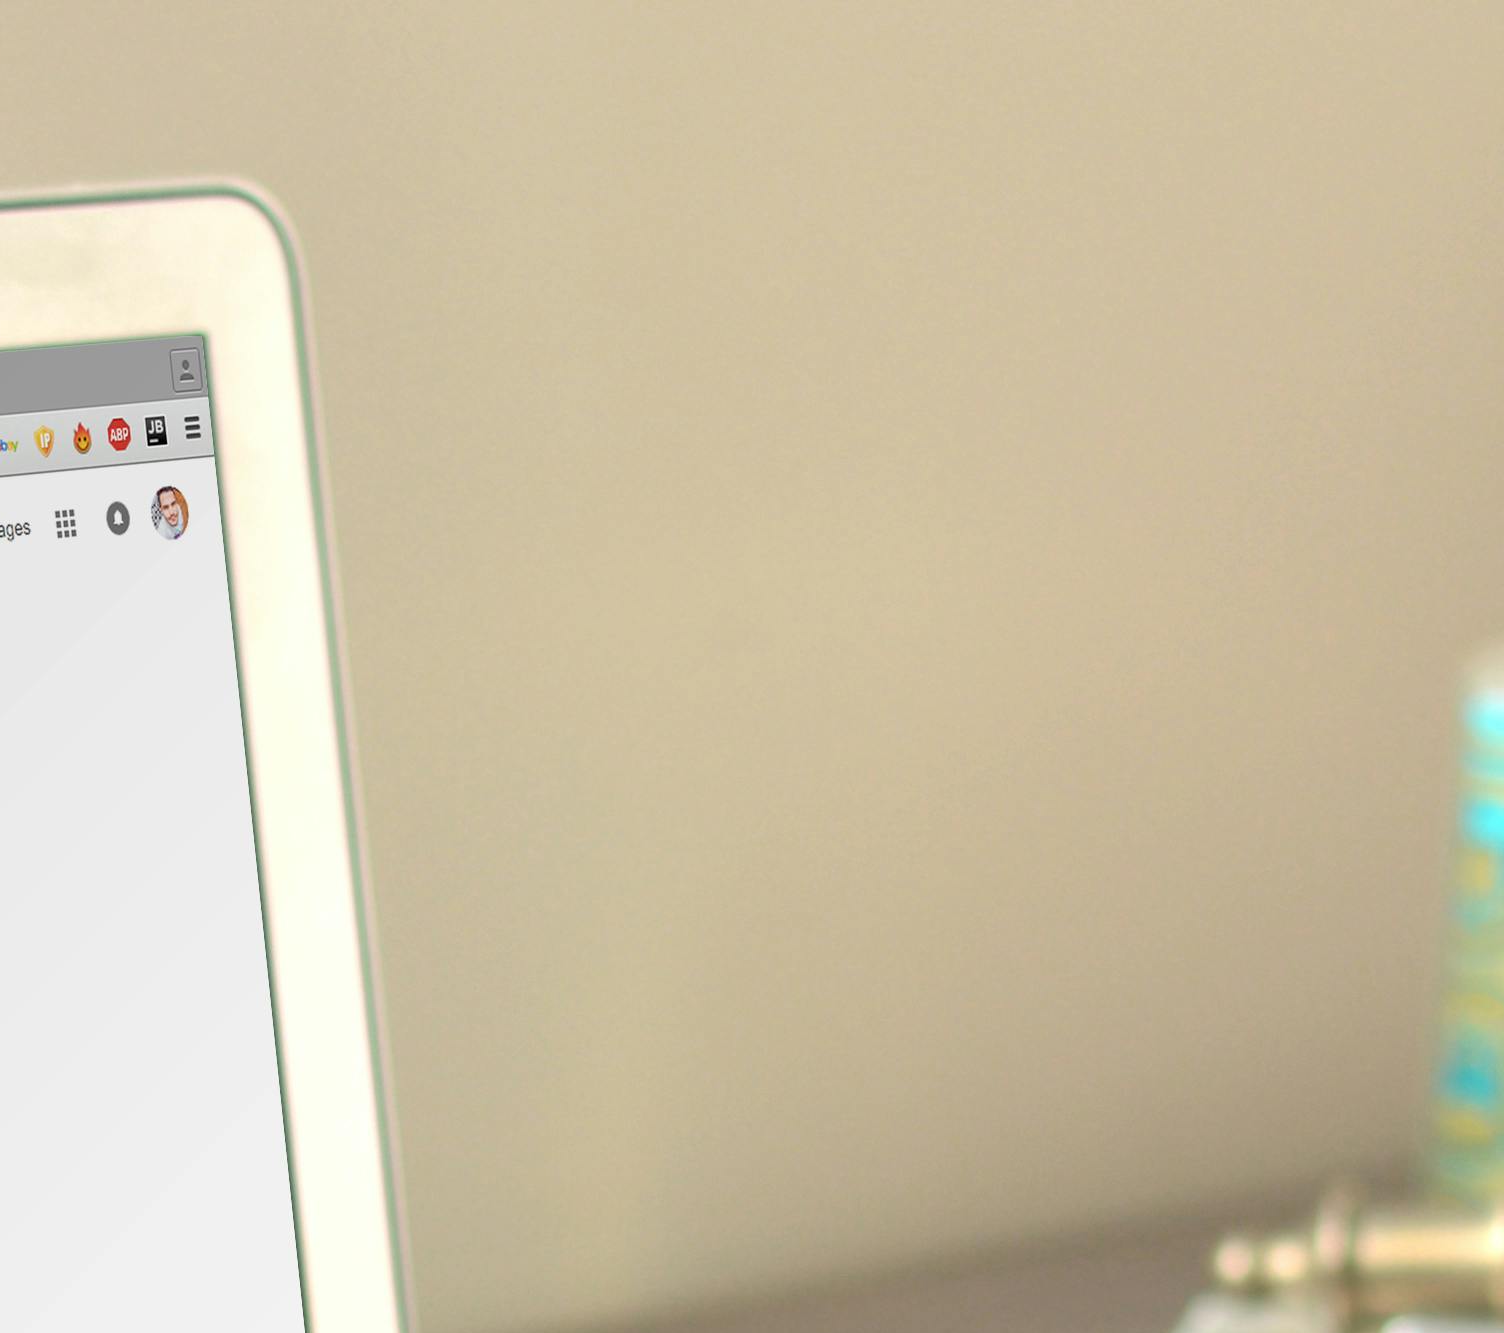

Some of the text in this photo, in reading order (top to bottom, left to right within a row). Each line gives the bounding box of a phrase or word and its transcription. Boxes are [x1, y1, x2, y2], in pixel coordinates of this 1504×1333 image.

[147, 418, 164, 434] JB
[39, 434, 51, 449] IP
[110, 427, 129, 443] ABP
